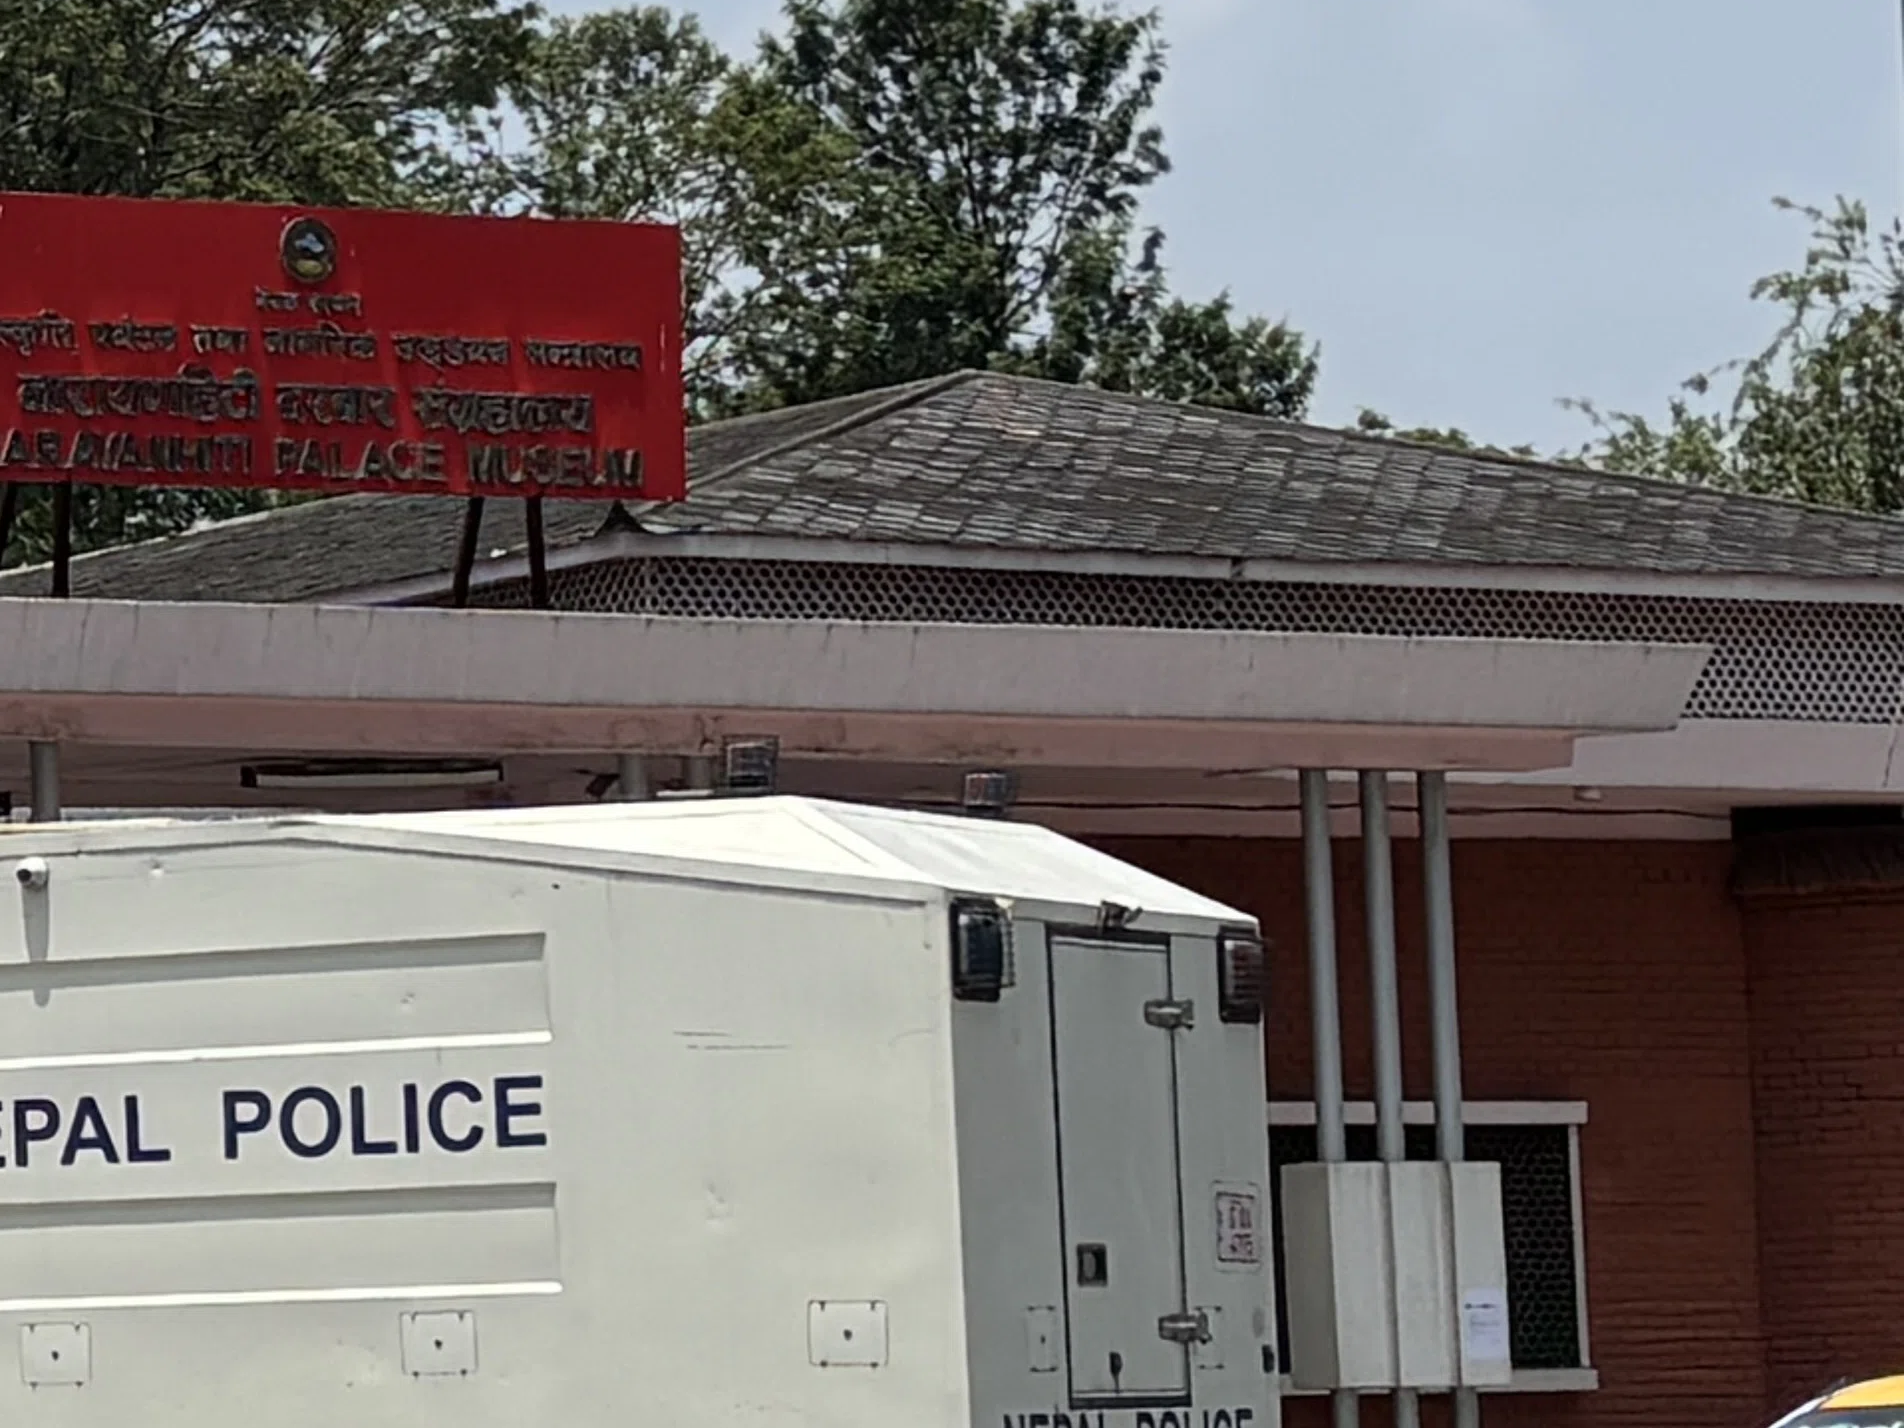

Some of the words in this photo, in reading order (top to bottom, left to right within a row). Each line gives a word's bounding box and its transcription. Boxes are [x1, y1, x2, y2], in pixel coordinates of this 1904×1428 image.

[274, 436, 448, 483] PALACE
[466, 443, 644, 488] MUSEUM
[222, 1075, 547, 1160] POLICE
